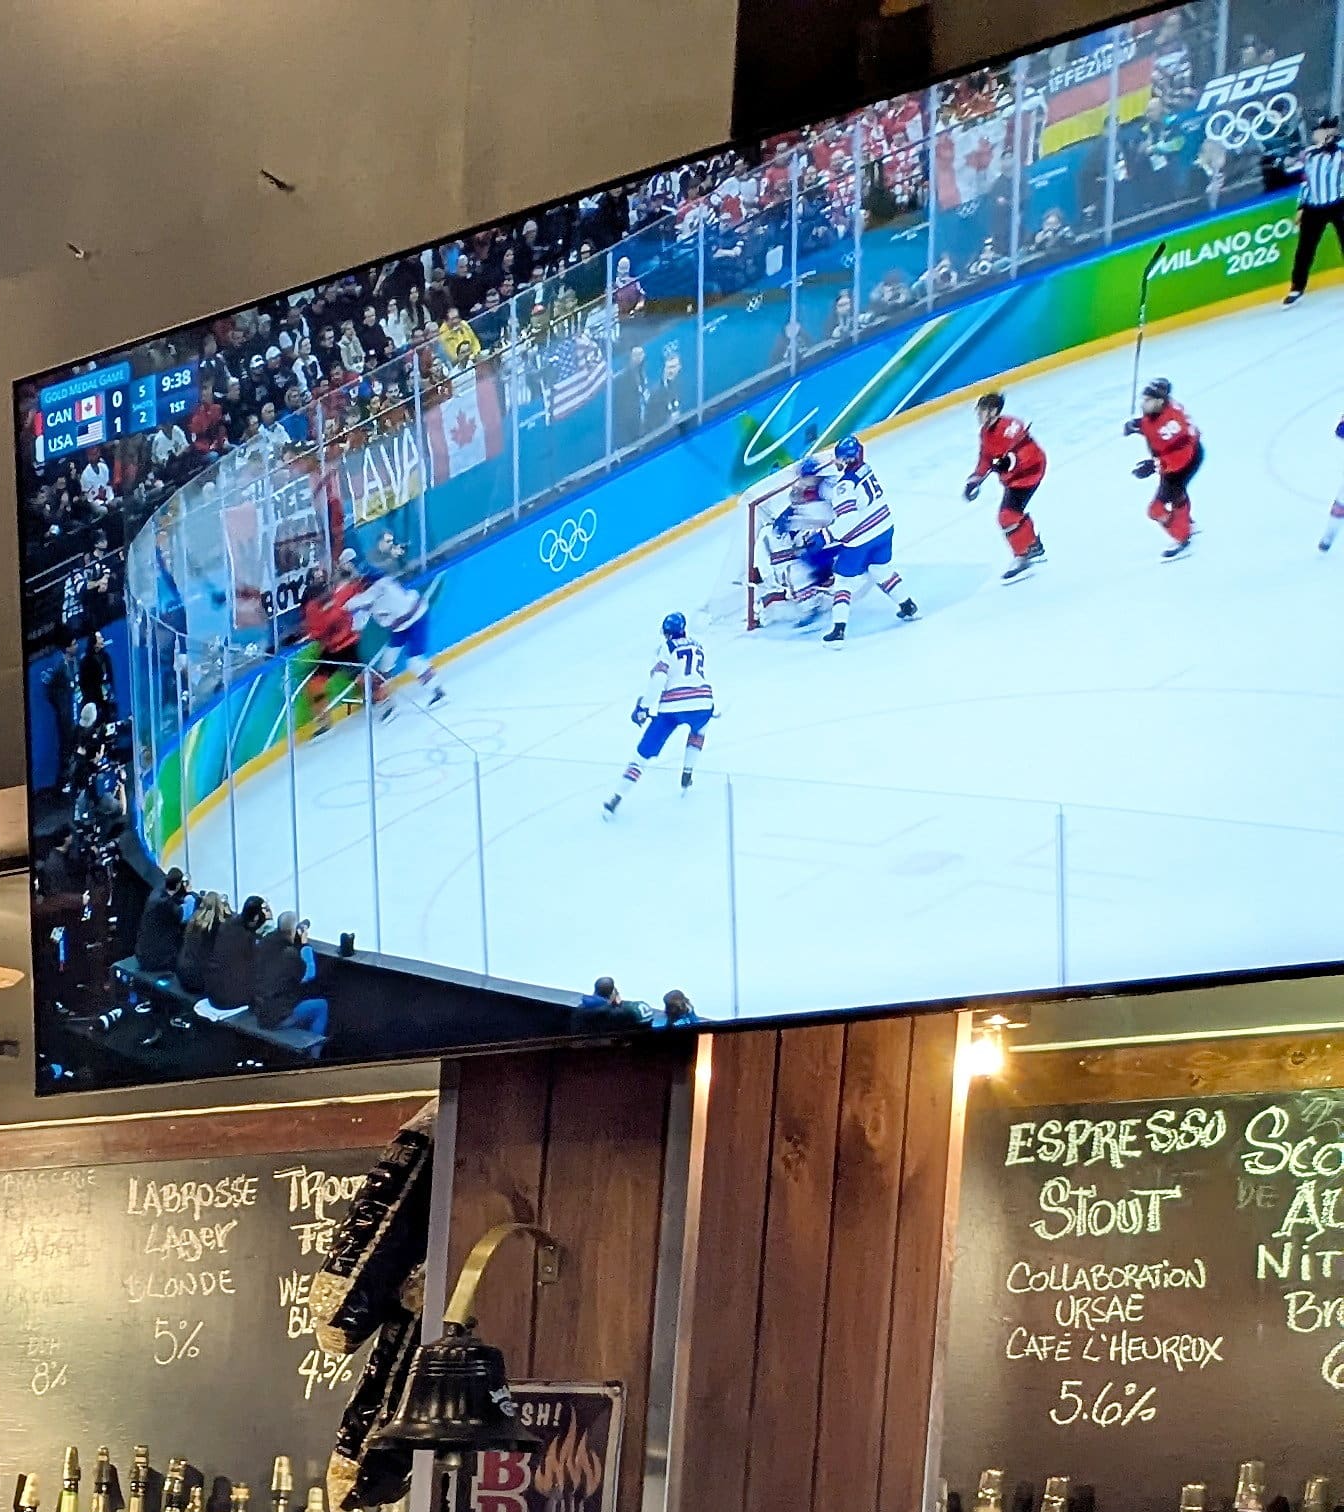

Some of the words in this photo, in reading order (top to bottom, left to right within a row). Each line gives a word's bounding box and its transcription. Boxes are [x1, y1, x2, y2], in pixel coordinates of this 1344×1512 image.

[1147, 230, 1249, 280] MILANO
[1252, 218, 1298, 246] CO
[1226, 245, 1281, 276] 2026
[44, 388, 69, 404] GOLD
[69, 380, 99, 396] MEDAL
[99, 371, 125, 387] GAME
[138, 385, 146, 398] 5
[162, 369, 192, 392] 9:38
[46, 408, 72, 428] CAN
[112, 391, 123, 408] 0
[139, 412, 147, 424] 2
[169, 400, 186, 414] 1ST
[48, 436, 74, 453] USA
[114, 417, 122, 433] 1
[1005, 1109, 1227, 1168] ESPRESSO
[1240, 1105, 1344, 1178] SCO
[127, 1173, 260, 1222] LABROSSE
[273, 1165, 369, 1226] TROU
[1031, 1176, 1182, 1241] STOUT
[1272, 1180, 1344, 1242] AL
[123, 1270, 237, 1303] BLONDE
[278, 1270, 312, 1308] WE
[1056, 1294, 1145, 1327] URSAE
[153, 1317, 205, 1365] 5%
[31, 1361, 69, 1396] 8%
[298, 1350, 354, 1400] 4.5%
[1049, 1381, 1158, 1428] 5.6%
